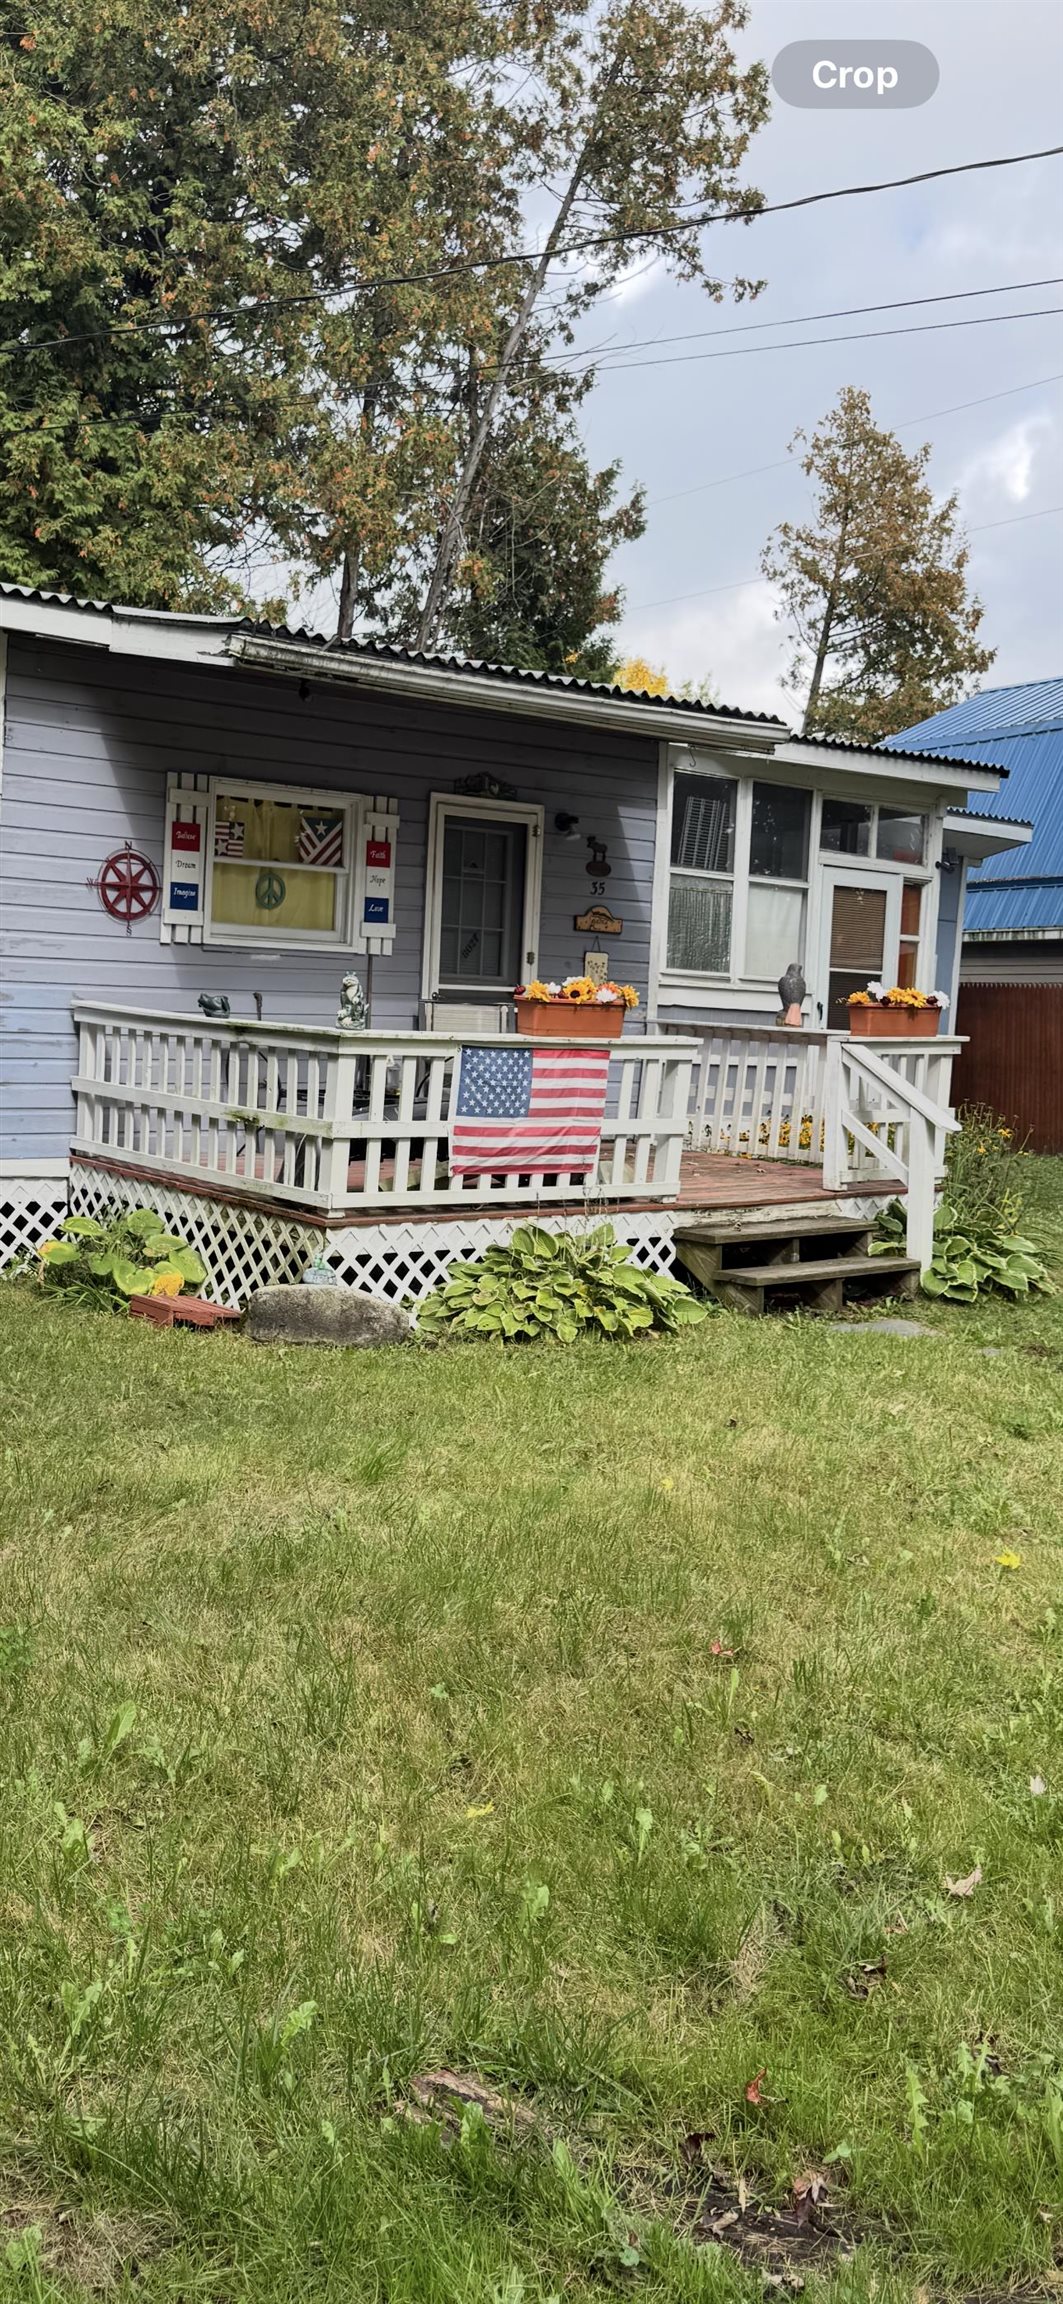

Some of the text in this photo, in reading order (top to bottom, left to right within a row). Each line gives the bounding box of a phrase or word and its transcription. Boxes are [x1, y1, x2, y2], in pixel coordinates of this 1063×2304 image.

[125, 840, 133, 850] N
[370, 850, 386, 859] Faith
[175, 860, 196, 869] Dream
[173, 887, 196, 899] Imagine
[590, 881, 605, 896] 35
[368, 904, 384, 912] Love
[126, 925, 133, 936] S
